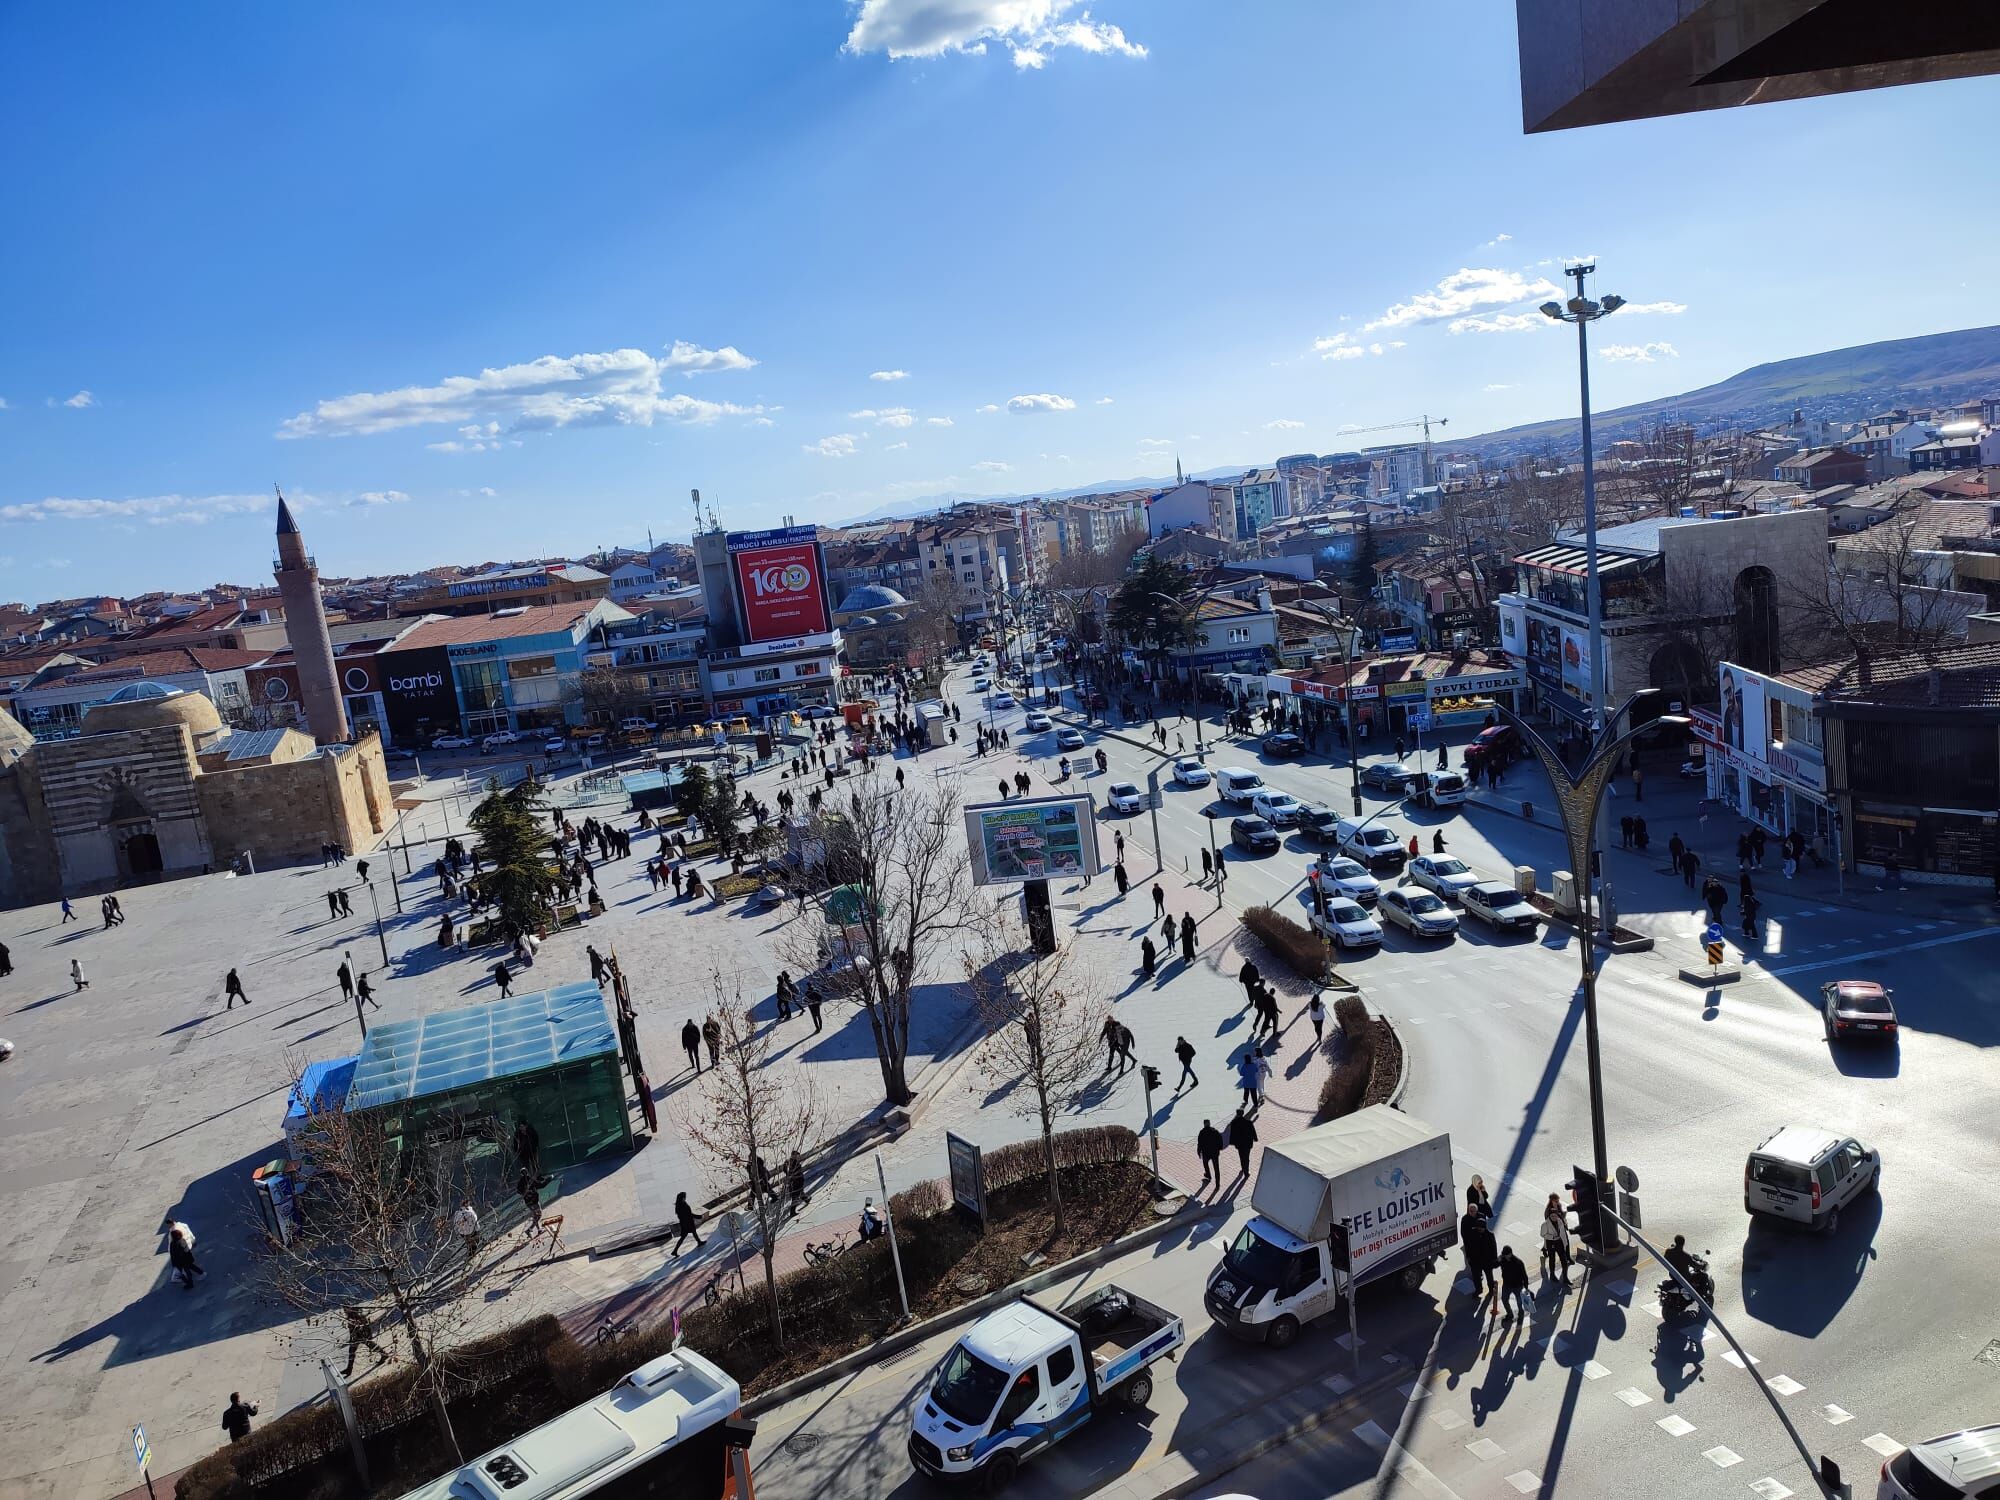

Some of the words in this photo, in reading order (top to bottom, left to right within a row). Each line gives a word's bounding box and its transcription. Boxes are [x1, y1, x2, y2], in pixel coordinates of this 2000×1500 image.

[728, 541, 760, 551] SÜRÜCÜ
[761, 537, 788, 547] KURSU
[768, 641, 797, 651] DenizBank
[389, 671, 443, 691] bambi
[1433, 680, 1473, 696] ŞEVKİ
[1476, 677, 1520, 689] TURAK
[402, 690, 435, 699] YATAK
[1351, 686, 1377, 696] CZANE
[1377, 1181, 1446, 1224] LOJİSTİK
[1368, 1240, 1384, 1252] DIŞI
[1384, 1224, 1420, 1245] TESLİMATI
[1420, 1213, 1447, 1229] YAPILIR
